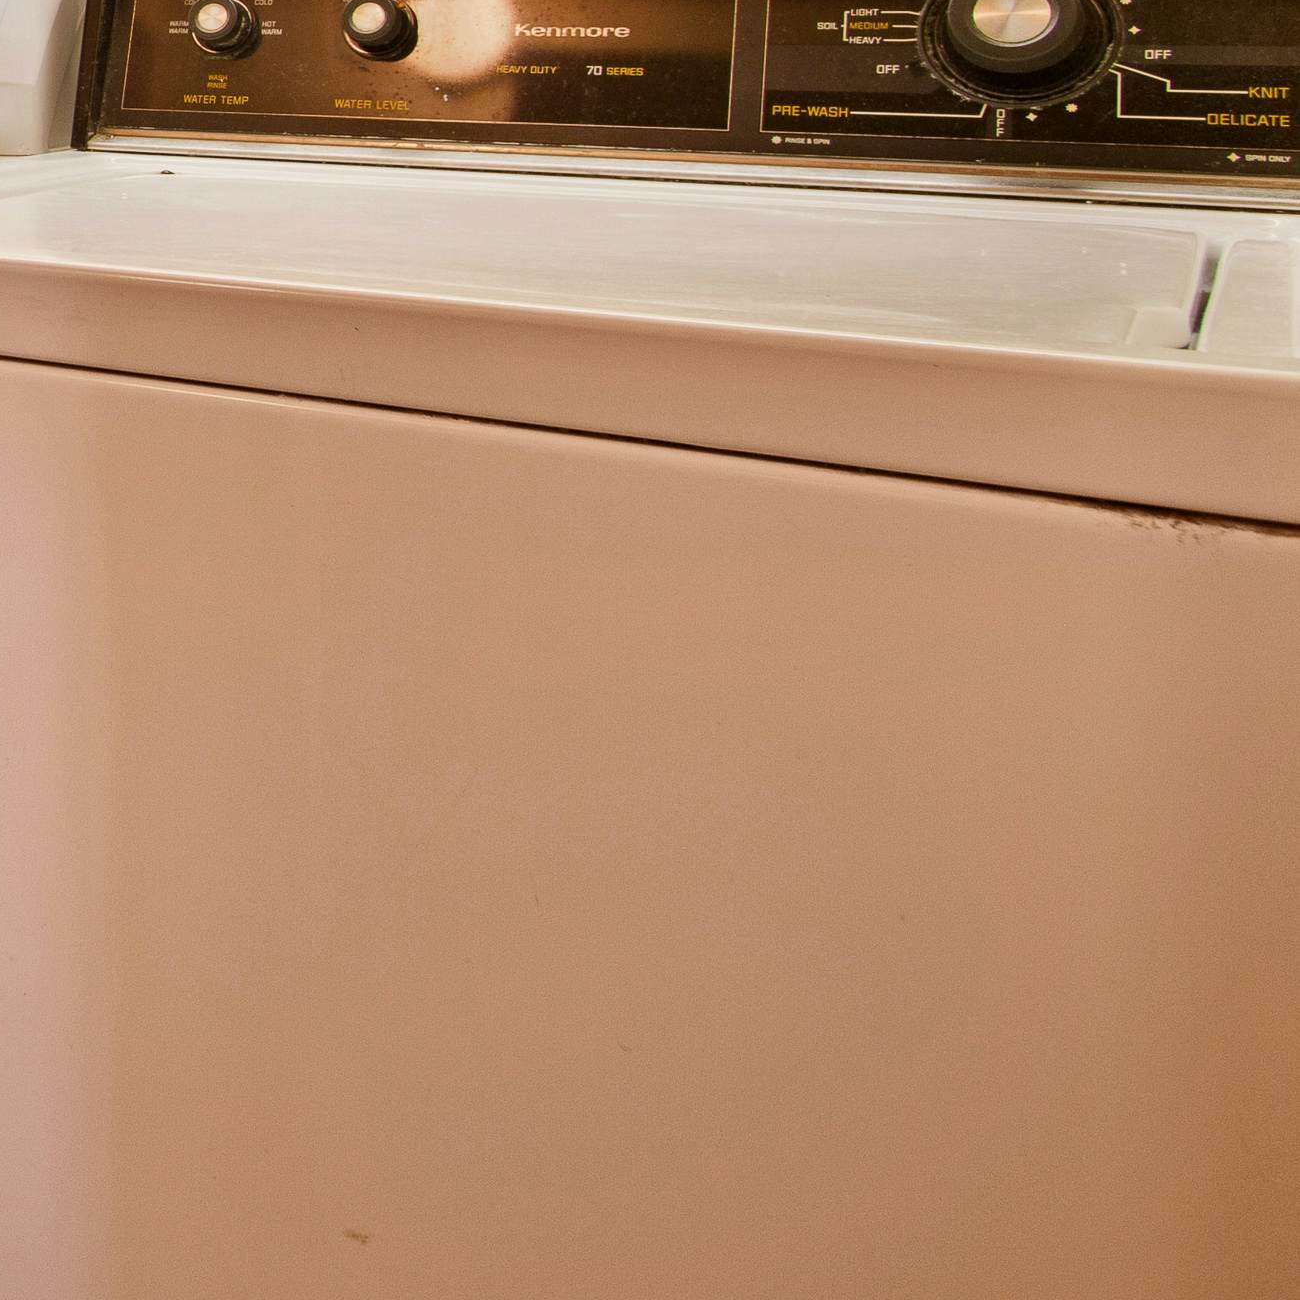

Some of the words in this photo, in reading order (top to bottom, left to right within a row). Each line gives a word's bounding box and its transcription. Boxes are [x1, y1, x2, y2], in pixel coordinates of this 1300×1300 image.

[850, 8, 880, 17] LIGHT
[261, 20, 277, 28] HOT
[816, 21, 839, 30] SOIL
[849, 21, 890, 30] MEDIUM
[168, 27, 189, 35] WARM
[260, 28, 283, 36] WARM
[514, 23, 630, 38] Kenmore
[848, 35, 883, 45] HEAVY
[1145, 50, 1172, 59] OFF
[496, 65, 528, 75] HEAVY
[530, 65, 558, 75] DUTY
[586, 66, 602, 75] 70
[607, 67, 644, 76] SERIES
[876, 64, 900, 74] OFF
[1248, 87, 1289, 99] KNIT
[184, 95, 216, 104] WATER
[221, 96, 249, 105] TEMP
[334, 99, 372, 108] WATER
[376, 100, 410, 110] LEVEL
[772, 105, 848, 117] PRE-WASH
[1207, 113, 1290, 127] DELICATE
[1244, 154, 1268, 162] SPIN
[1268, 155, 1292, 164] ONLY
